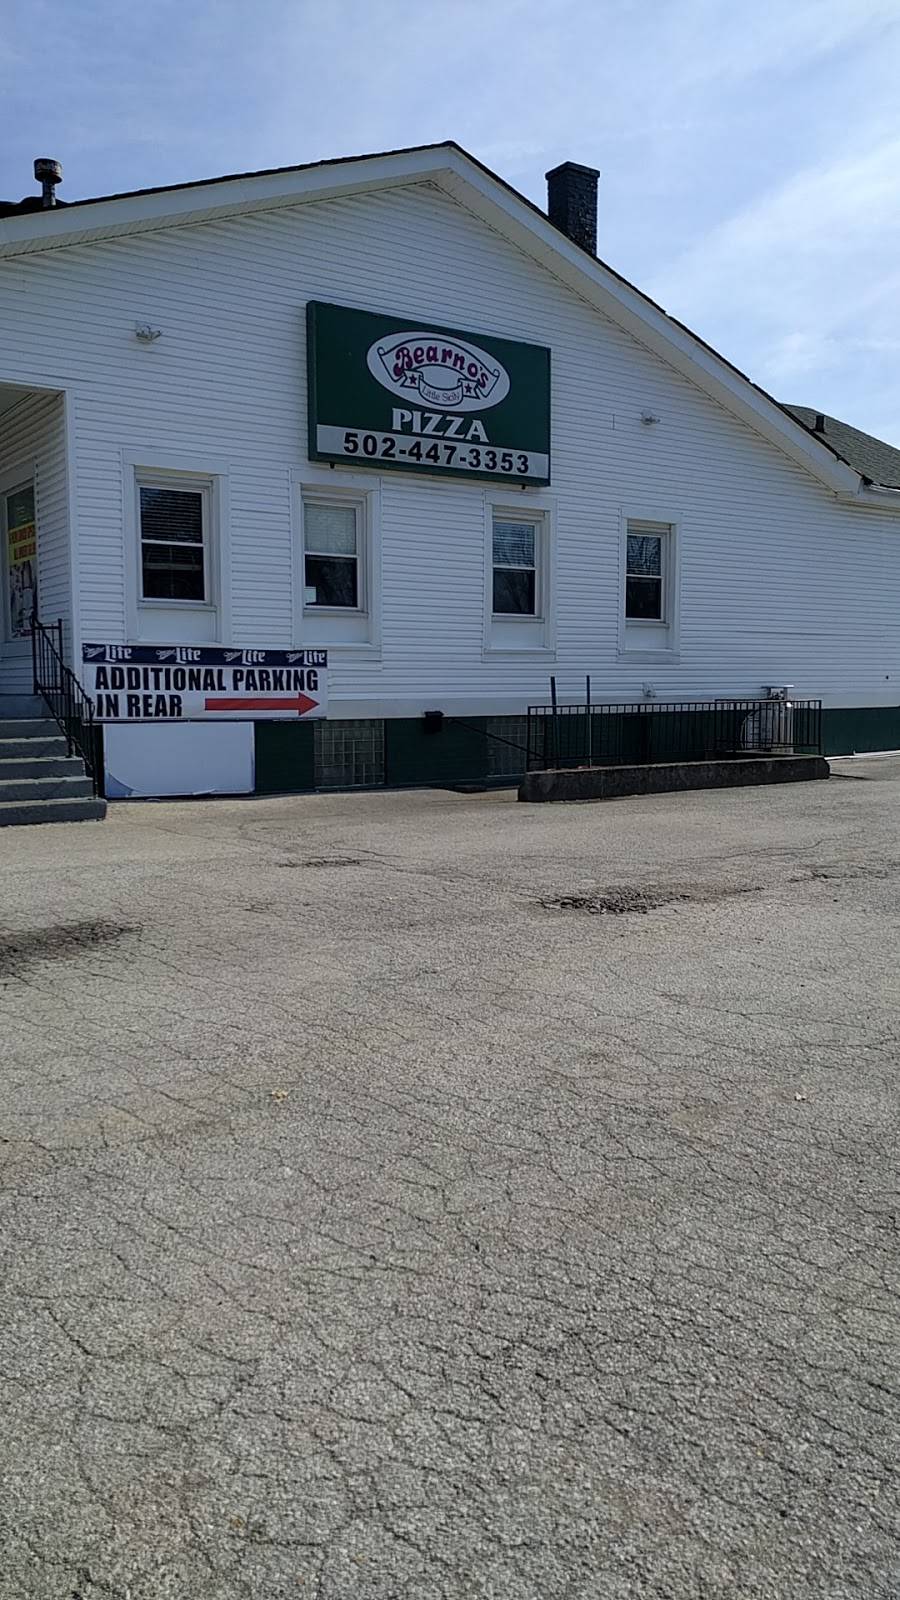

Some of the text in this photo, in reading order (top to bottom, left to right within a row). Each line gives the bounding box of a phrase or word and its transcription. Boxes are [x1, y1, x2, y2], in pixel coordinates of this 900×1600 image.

[393, 345, 489, 389] Bearno's
[422, 386, 441, 401] Little
[391, 408, 490, 443] PIZZA
[343, 432, 530, 475] 502-447-3353
[104, 645, 132, 663] Lite
[175, 647, 201, 664] Lite
[241, 649, 266, 666] Lite
[303, 650, 325, 666] Lite
[95, 666, 319, 692] ADDITIONAL PARKING
[96, 694, 183, 718] IN REAR
